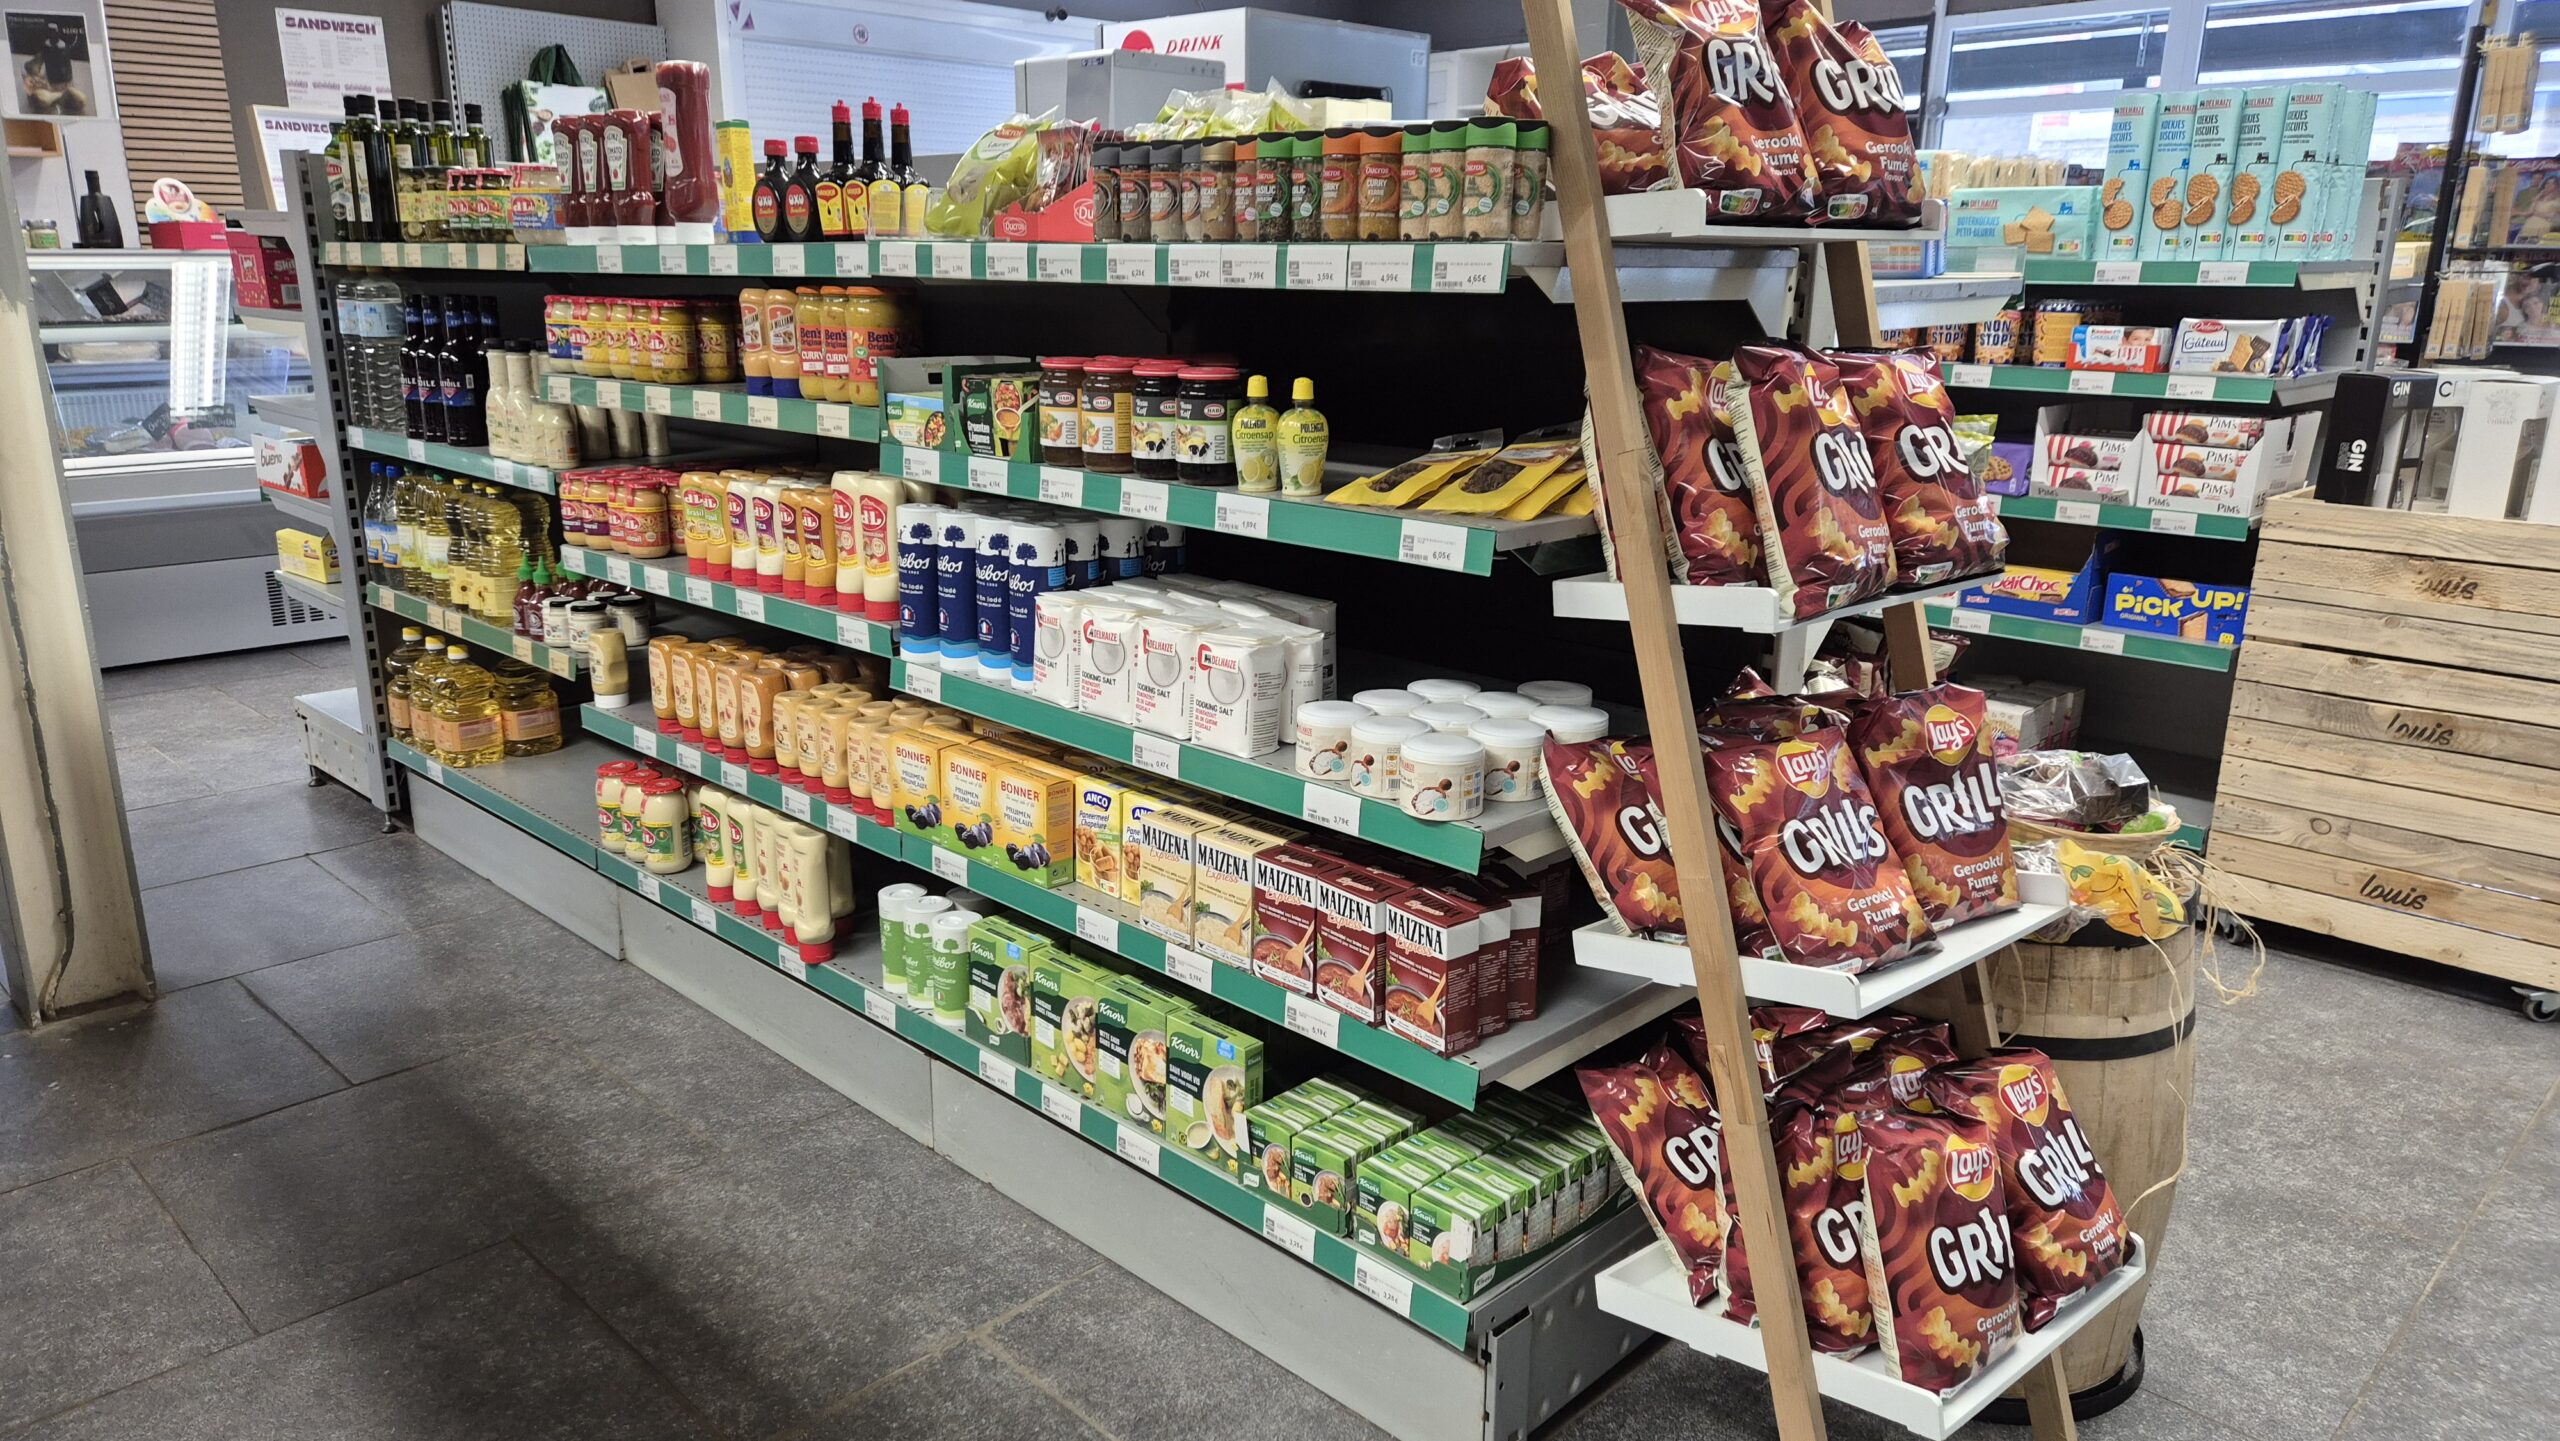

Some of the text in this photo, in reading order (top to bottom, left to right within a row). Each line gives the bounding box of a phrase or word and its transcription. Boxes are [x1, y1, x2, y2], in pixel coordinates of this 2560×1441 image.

[286, 17, 376, 35] SANDWICH
[1166, 34, 1223, 54] DRINK
[2206, 99, 2232, 108] DELHAIZE
[2297, 95, 2324, 104] DELHAIZE
[2120, 107, 2144, 116] DELHAIZE
[265, 120, 330, 133] SANDWIC
[2161, 120, 2185, 130] KOEKJES
[2159, 131, 2186, 141] BISCUITS
[1761, 152, 1800, 166] Fumé
[1880, 156, 1909, 172] Fumé
[758, 195, 772, 206] OXO
[789, 194, 804, 205] OXO
[1005, 223, 1025, 231] Ducros
[1317, 273, 1333, 282] 3,59€
[1380, 274, 1398, 282] 4,99€
[1467, 275, 1486, 285] 4,65€
[774, 316, 794, 328] WILLIAM
[1984, 320, 2011, 332] NON
[800, 328, 822, 338] Ben's
[825, 330, 847, 339] Ben's
[868, 331, 894, 342] Ben's
[1932, 333, 1965, 343] STOP!
[1980, 334, 2012, 347] STOP!
[2184, 337, 2225, 349] Gâteau
[802, 351, 823, 360] CURRY
[826, 353, 848, 363] CURRY
[2393, 382, 2411, 396] GIN
[967, 399, 986, 409] Knorr
[1066, 420, 1077, 445] FOND
[1102, 425, 1113, 451] FOND
[1235, 430, 1274, 440] Citroensap
[1214, 434, 1226, 461] FOND
[2348, 439, 2367, 472] GIN
[261, 451, 282, 467] bueno
[898, 553, 930, 573] rébos
[1432, 552, 1451, 561] 6,05€
[938, 558, 962, 573] ébos
[1009, 574, 1035, 592] ébos
[1991, 575, 2060, 592] DéliChoc
[2191, 589, 2248, 611] UP!
[1093, 630, 1117, 642] DELHAIZE
[1149, 640, 1173, 653] DELHAIZE
[1047, 660, 1057, 669] SALT
[1211, 656, 1237, 670] DELHAIZE
[1082, 671, 1116, 686] COOKING SALT
[1137, 682, 1170, 698] COOKING SALT
[1196, 699, 1233, 717] COOKING SALT
[982, 728, 999, 739] BON
[1929, 718, 1971, 751] Lay's
[2387, 713, 2453, 746] louis
[896, 747, 931, 765] BONNER
[950, 762, 988, 782] BONNER
[1780, 746, 1827, 784] Lay's
[955, 787, 979, 799] PRUIMEN
[1001, 781, 1040, 802] BONNER
[953, 793, 981, 808] PRUNEAUX
[1085, 793, 1108, 807] ANCO
[1004, 813, 1033, 828] PRUNEAUX
[1005, 806, 1031, 819] PRUIMEN
[1079, 810, 1109, 821] Paneermeel
[1333, 815, 1349, 826] 3,79€
[1081, 818, 1107, 830] Chapelure
[1142, 824, 1190, 861] MAIZENA
[1783, 799, 1886, 874] GRILLS
[1150, 846, 1180, 862] Express
[1198, 843, 1249, 882] MAIZENA
[1953, 855, 2004, 879] Gerookt/
[1206, 866, 1238, 884] Express
[1257, 862, 1313, 904] MAIZENA
[1966, 872, 1999, 891] Fumé
[1265, 887, 1303, 906] Express
[1971, 887, 1996, 900] flavour
[2359, 873, 2427, 910] louis
[1319, 885, 1373, 930] MAIZENA
[1327, 910, 1363, 931] Express
[1388, 907, 1443, 955] MAIZENA
[971, 943, 995, 960] Knorr
[1395, 934, 1434, 957] Express
[1035, 971, 1059, 991] Knorr
[1099, 1003, 1126, 1025] Knorr
[1171, 1036, 1200, 1059] Knorr
[1170, 1064, 1180, 1075] SAUS
[1181, 1069, 1192, 1082] VOOR
[2004, 1070, 2047, 1114] Lay's
[1294, 1149, 1315, 1166] Knorr
[1951, 1144, 1992, 1186] Lay's
[1359, 1176, 1380, 1194] Knorr
[1413, 1208, 1436, 1225] Knorr
